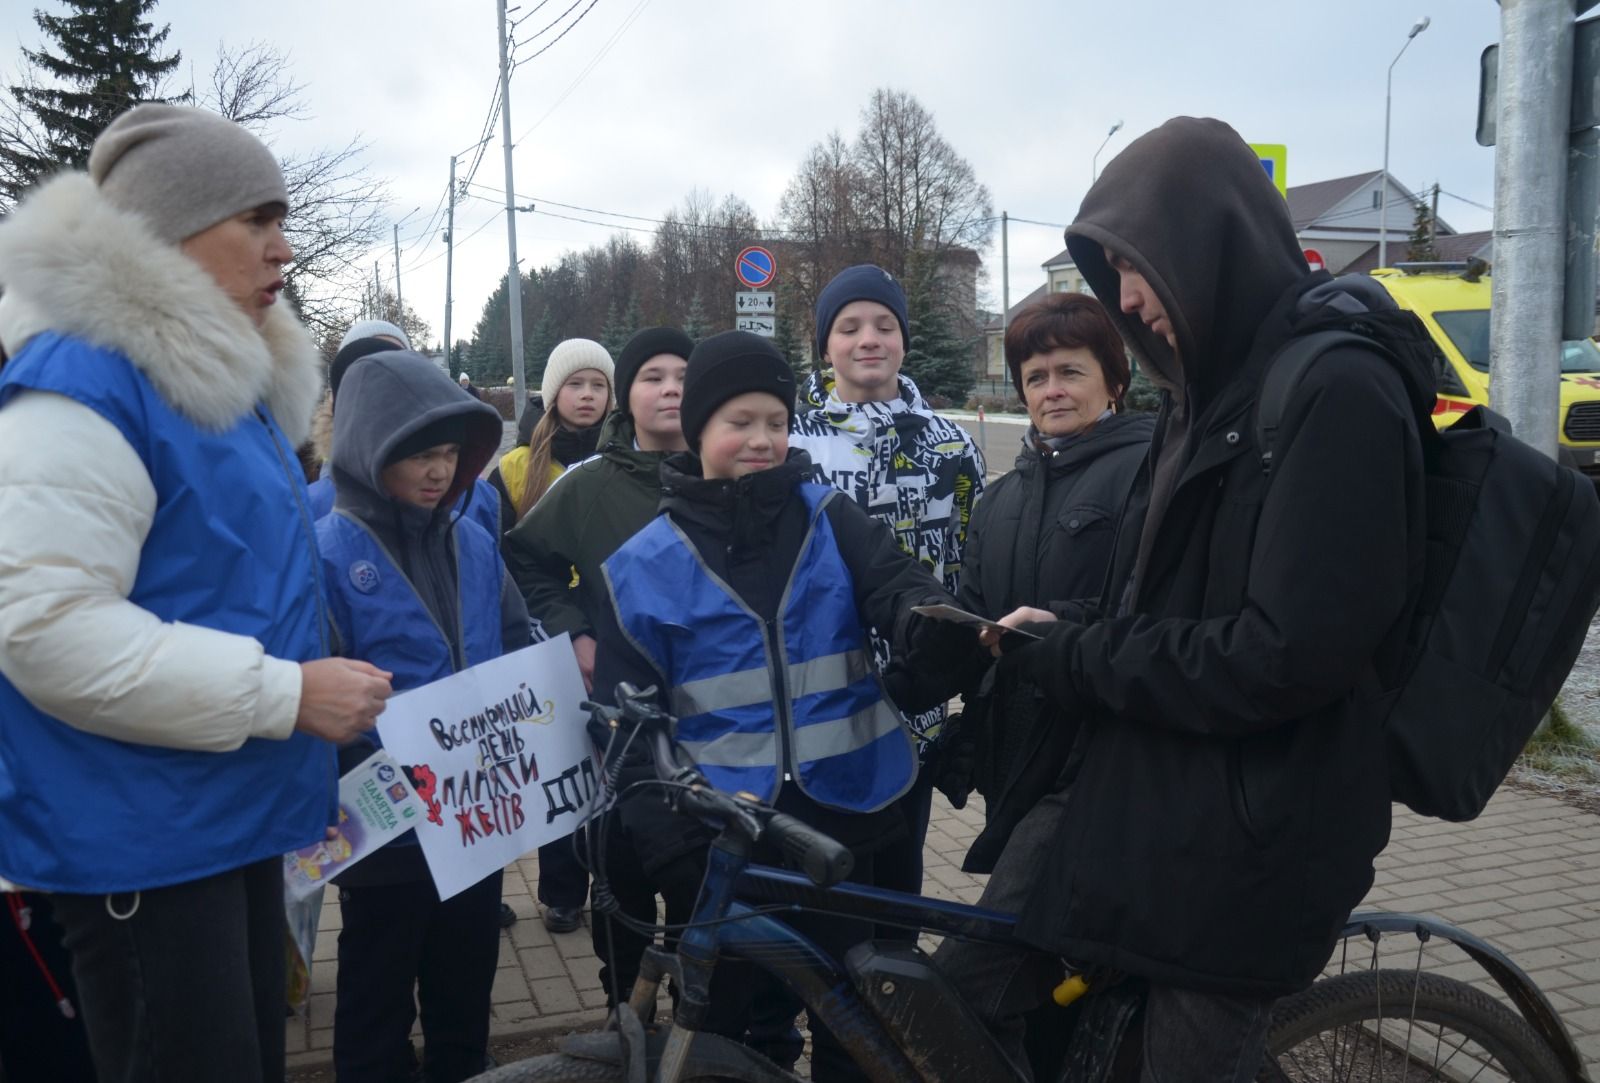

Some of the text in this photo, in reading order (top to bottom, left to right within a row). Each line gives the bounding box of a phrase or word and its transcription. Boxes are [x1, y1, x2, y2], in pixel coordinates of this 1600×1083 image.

[748, 297, 758, 307] 20
[923, 428, 960, 445] RIDE
[478, 726, 526, 767] ДЕНЬ
[442, 752, 539, 806] ПАМЯТИ
[541, 756, 597, 824] ДТП
[364, 779, 398, 829] ПАМЯТКА
